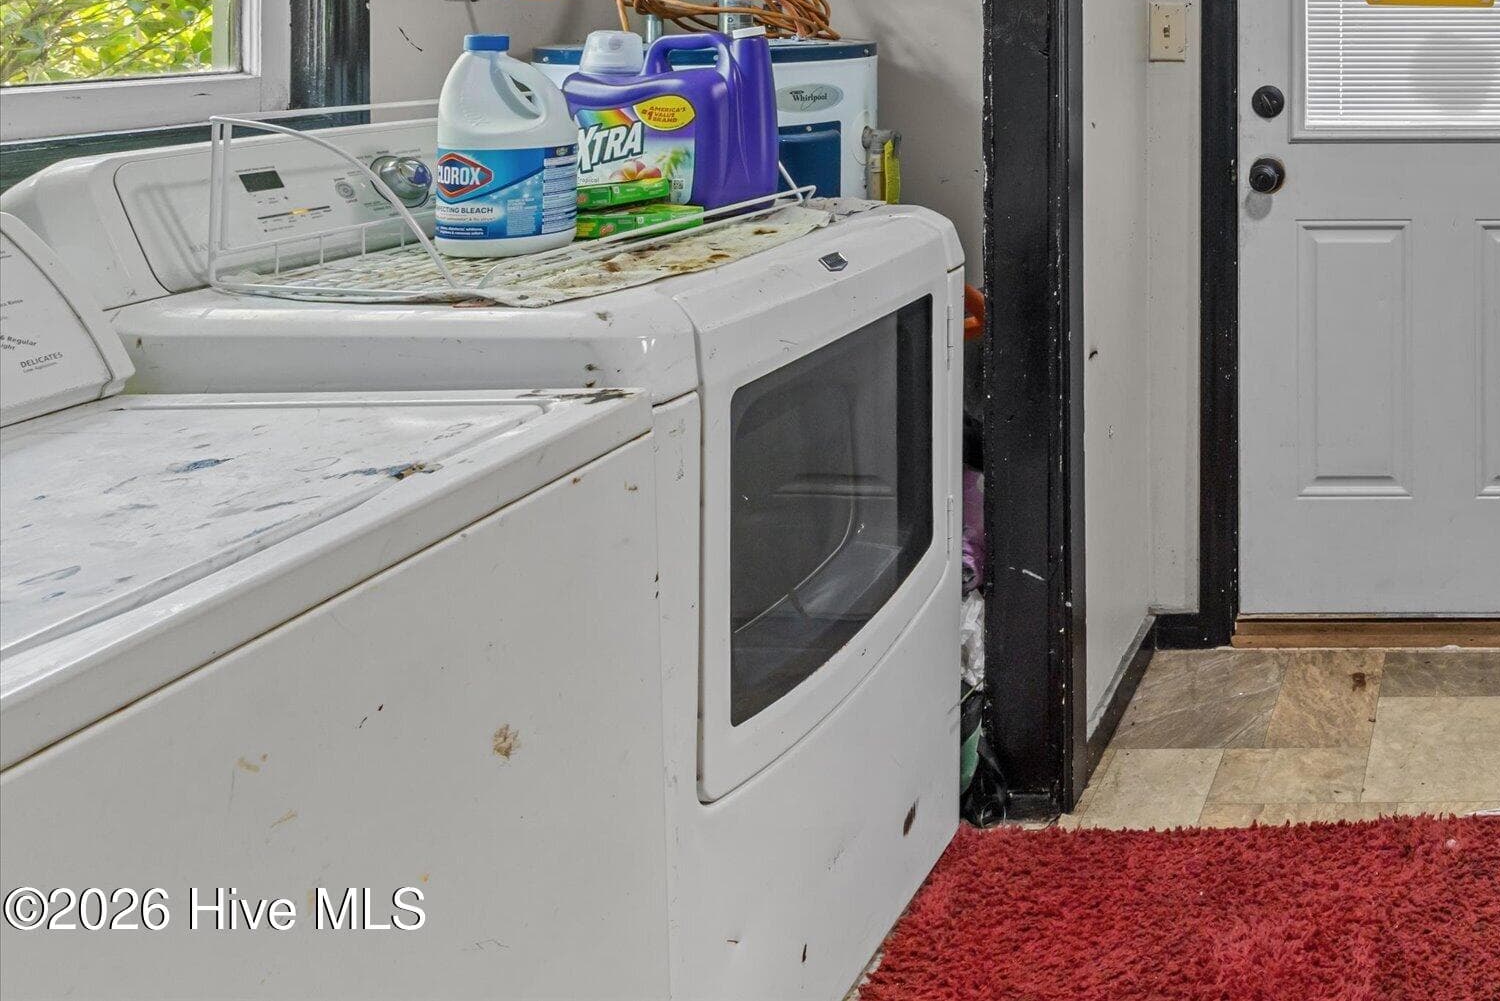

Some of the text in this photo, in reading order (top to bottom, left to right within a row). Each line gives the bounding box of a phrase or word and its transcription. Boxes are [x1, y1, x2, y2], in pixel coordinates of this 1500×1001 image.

[792, 93, 828, 102] Whirlpool
[577, 120, 643, 173] XTRA
[20, 351, 63, 369] DELICATES
